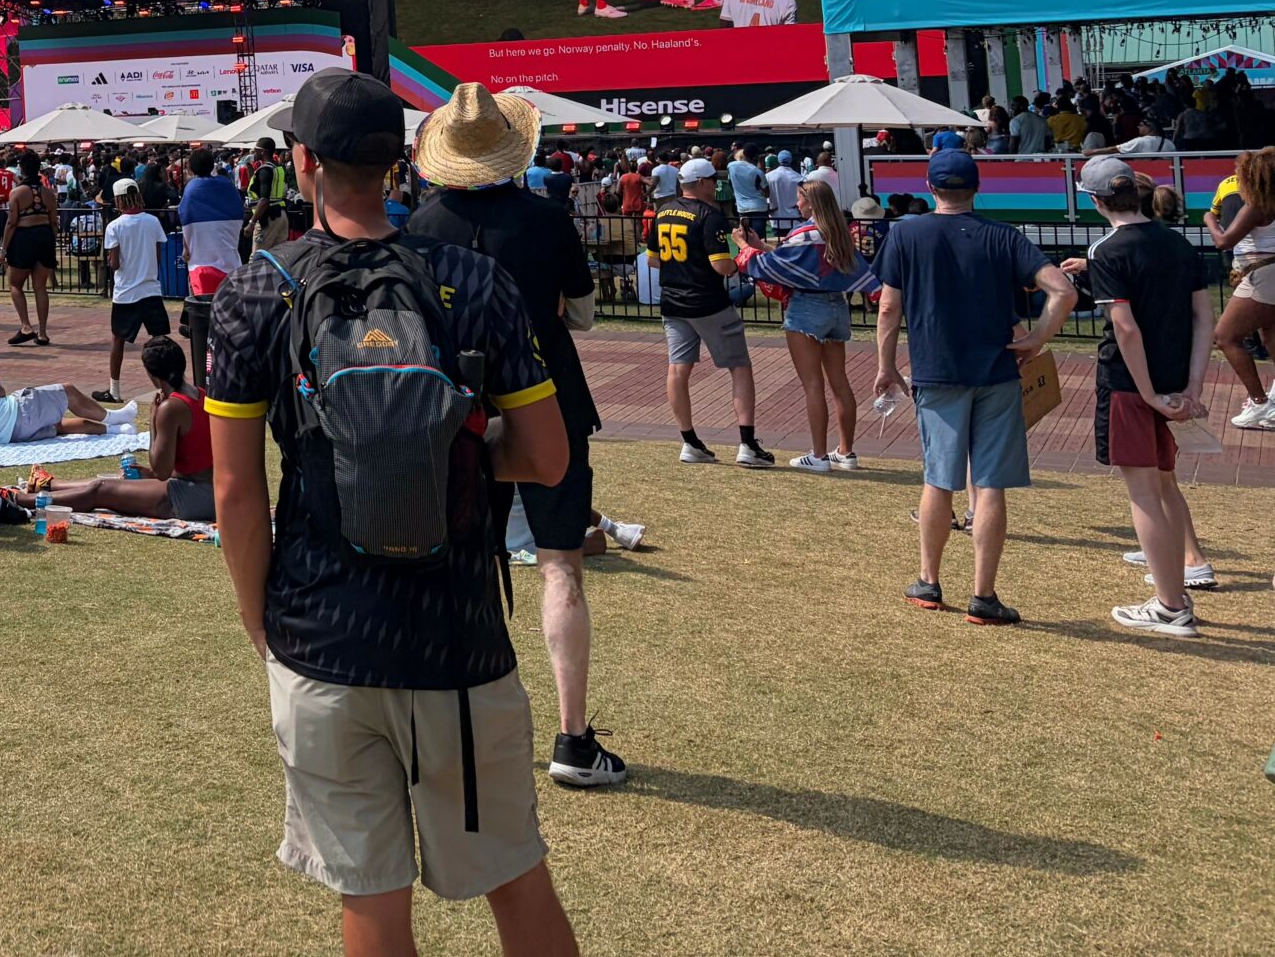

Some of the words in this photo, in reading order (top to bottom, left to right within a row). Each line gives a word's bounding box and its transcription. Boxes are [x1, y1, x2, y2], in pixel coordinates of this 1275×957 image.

[489, 49, 504, 58] But
[506, 48, 526, 57] here
[528, 48, 541, 56] we
[558, 45, 594, 55] Norway
[596, 41, 633, 54] penalty.
[651, 38, 702, 49] Haaland's.
[291, 63, 315, 73] VISA
[126, 71, 143, 79] ADI
[490, 75, 503, 84] No
[519, 74, 534, 82] the
[600, 98, 705, 115] Hisense
[657, 223, 688, 262] 55
[357, 340, 399, 348] GREGORY
